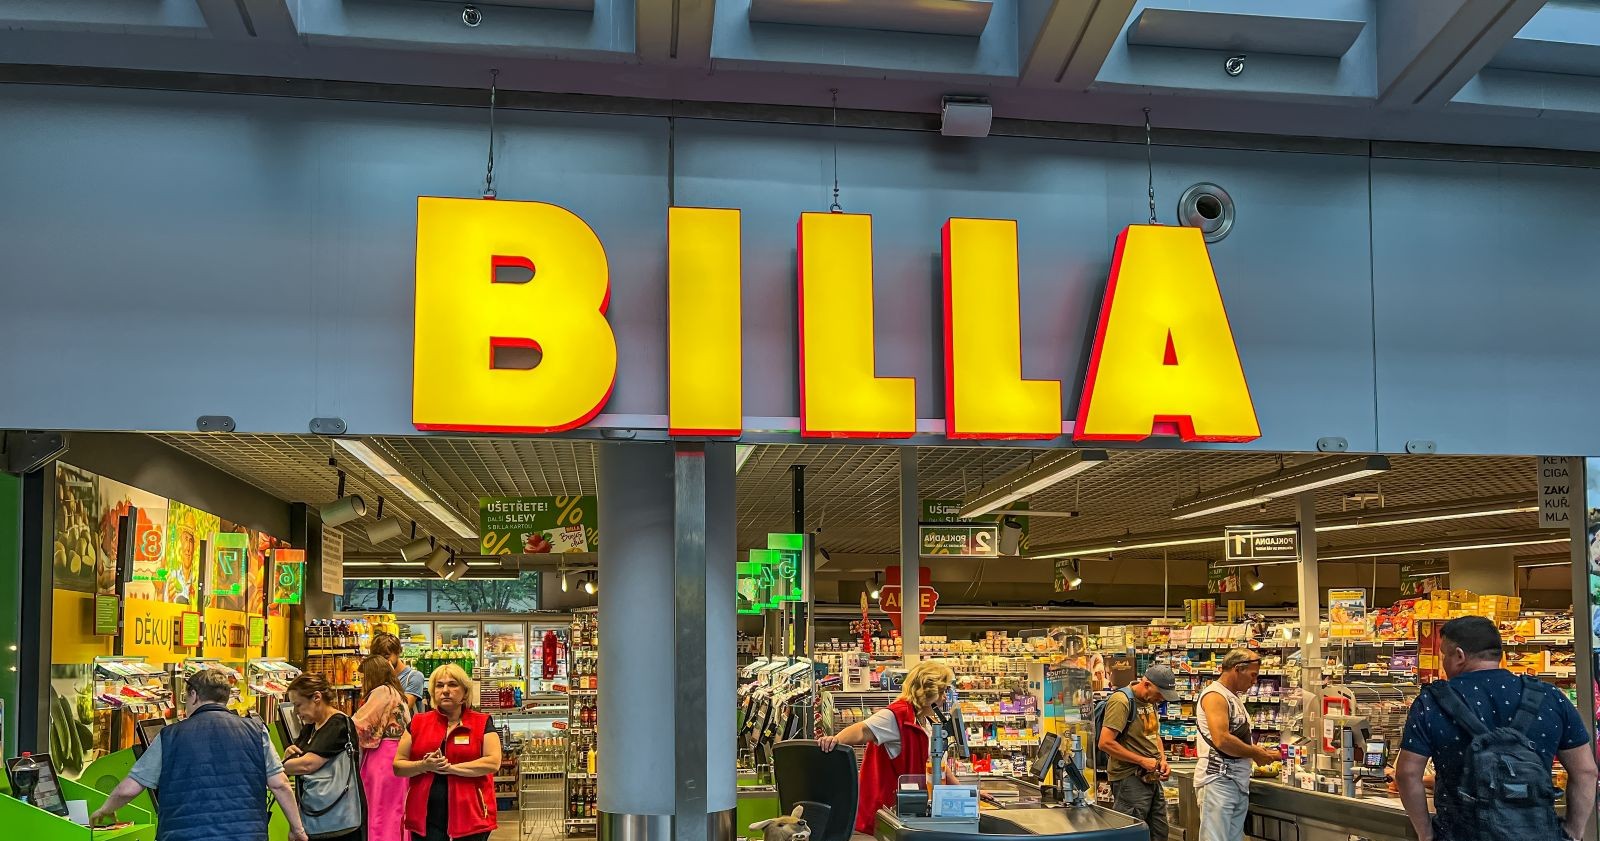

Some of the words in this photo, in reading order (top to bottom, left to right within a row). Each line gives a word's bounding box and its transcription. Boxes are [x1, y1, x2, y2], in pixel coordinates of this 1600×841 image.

[412, 195, 1263, 443] BILLA
[1543, 468, 1569, 478] CIGA
[487, 501, 548, 512] UŠETŘETE!
[1544, 496, 1570, 508] KUŘ
[505, 513, 536, 523] SLEVY
[1545, 512, 1569, 522] MLA
[885, 592, 931, 608] AE
[135, 612, 179, 651] DĚKUJE
[210, 620, 227, 648] VÁŠ
